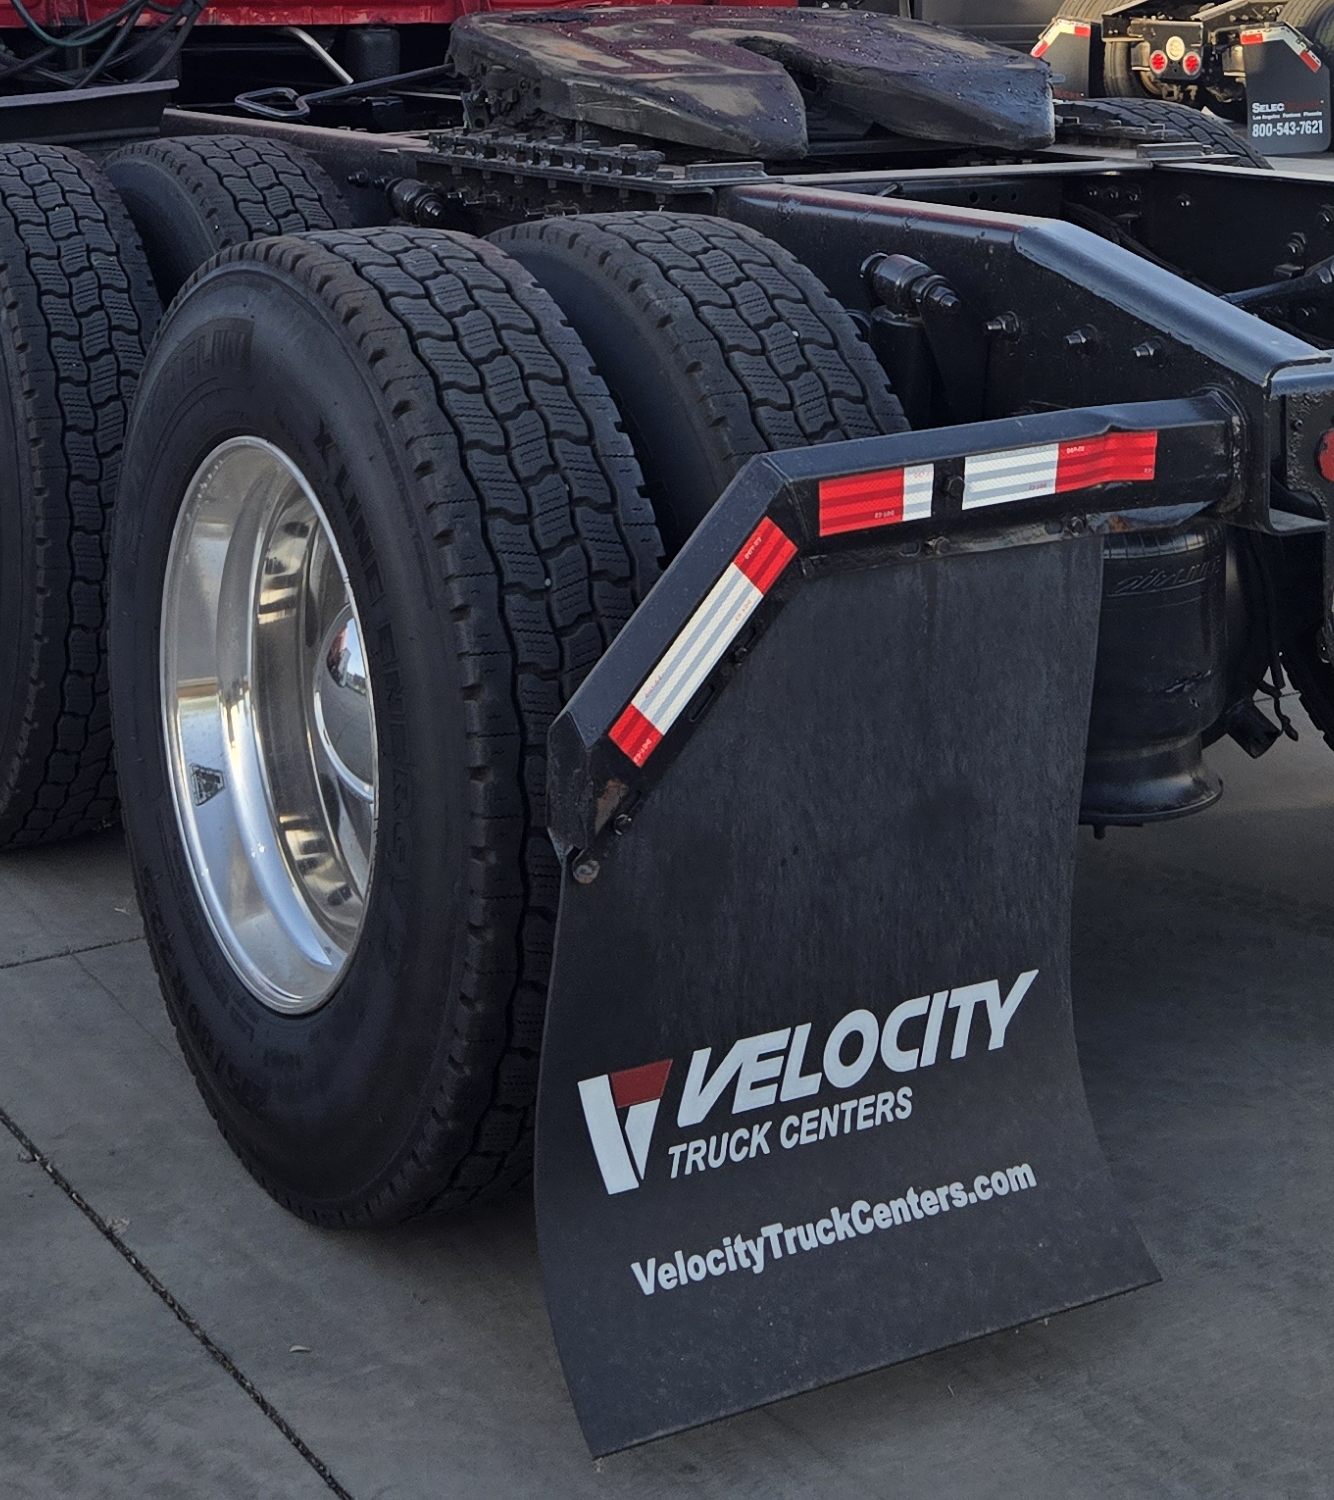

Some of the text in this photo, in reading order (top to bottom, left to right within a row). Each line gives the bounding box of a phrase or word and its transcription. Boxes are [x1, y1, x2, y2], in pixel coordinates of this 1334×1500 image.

[1252, 120, 1323, 137] 800-543-7621
[676, 969, 1040, 1128] VELOCITY
[667, 1085, 914, 1180] TRUCK CENTERS
[629, 1159, 1038, 1296] VelocityTruckCenters.com
